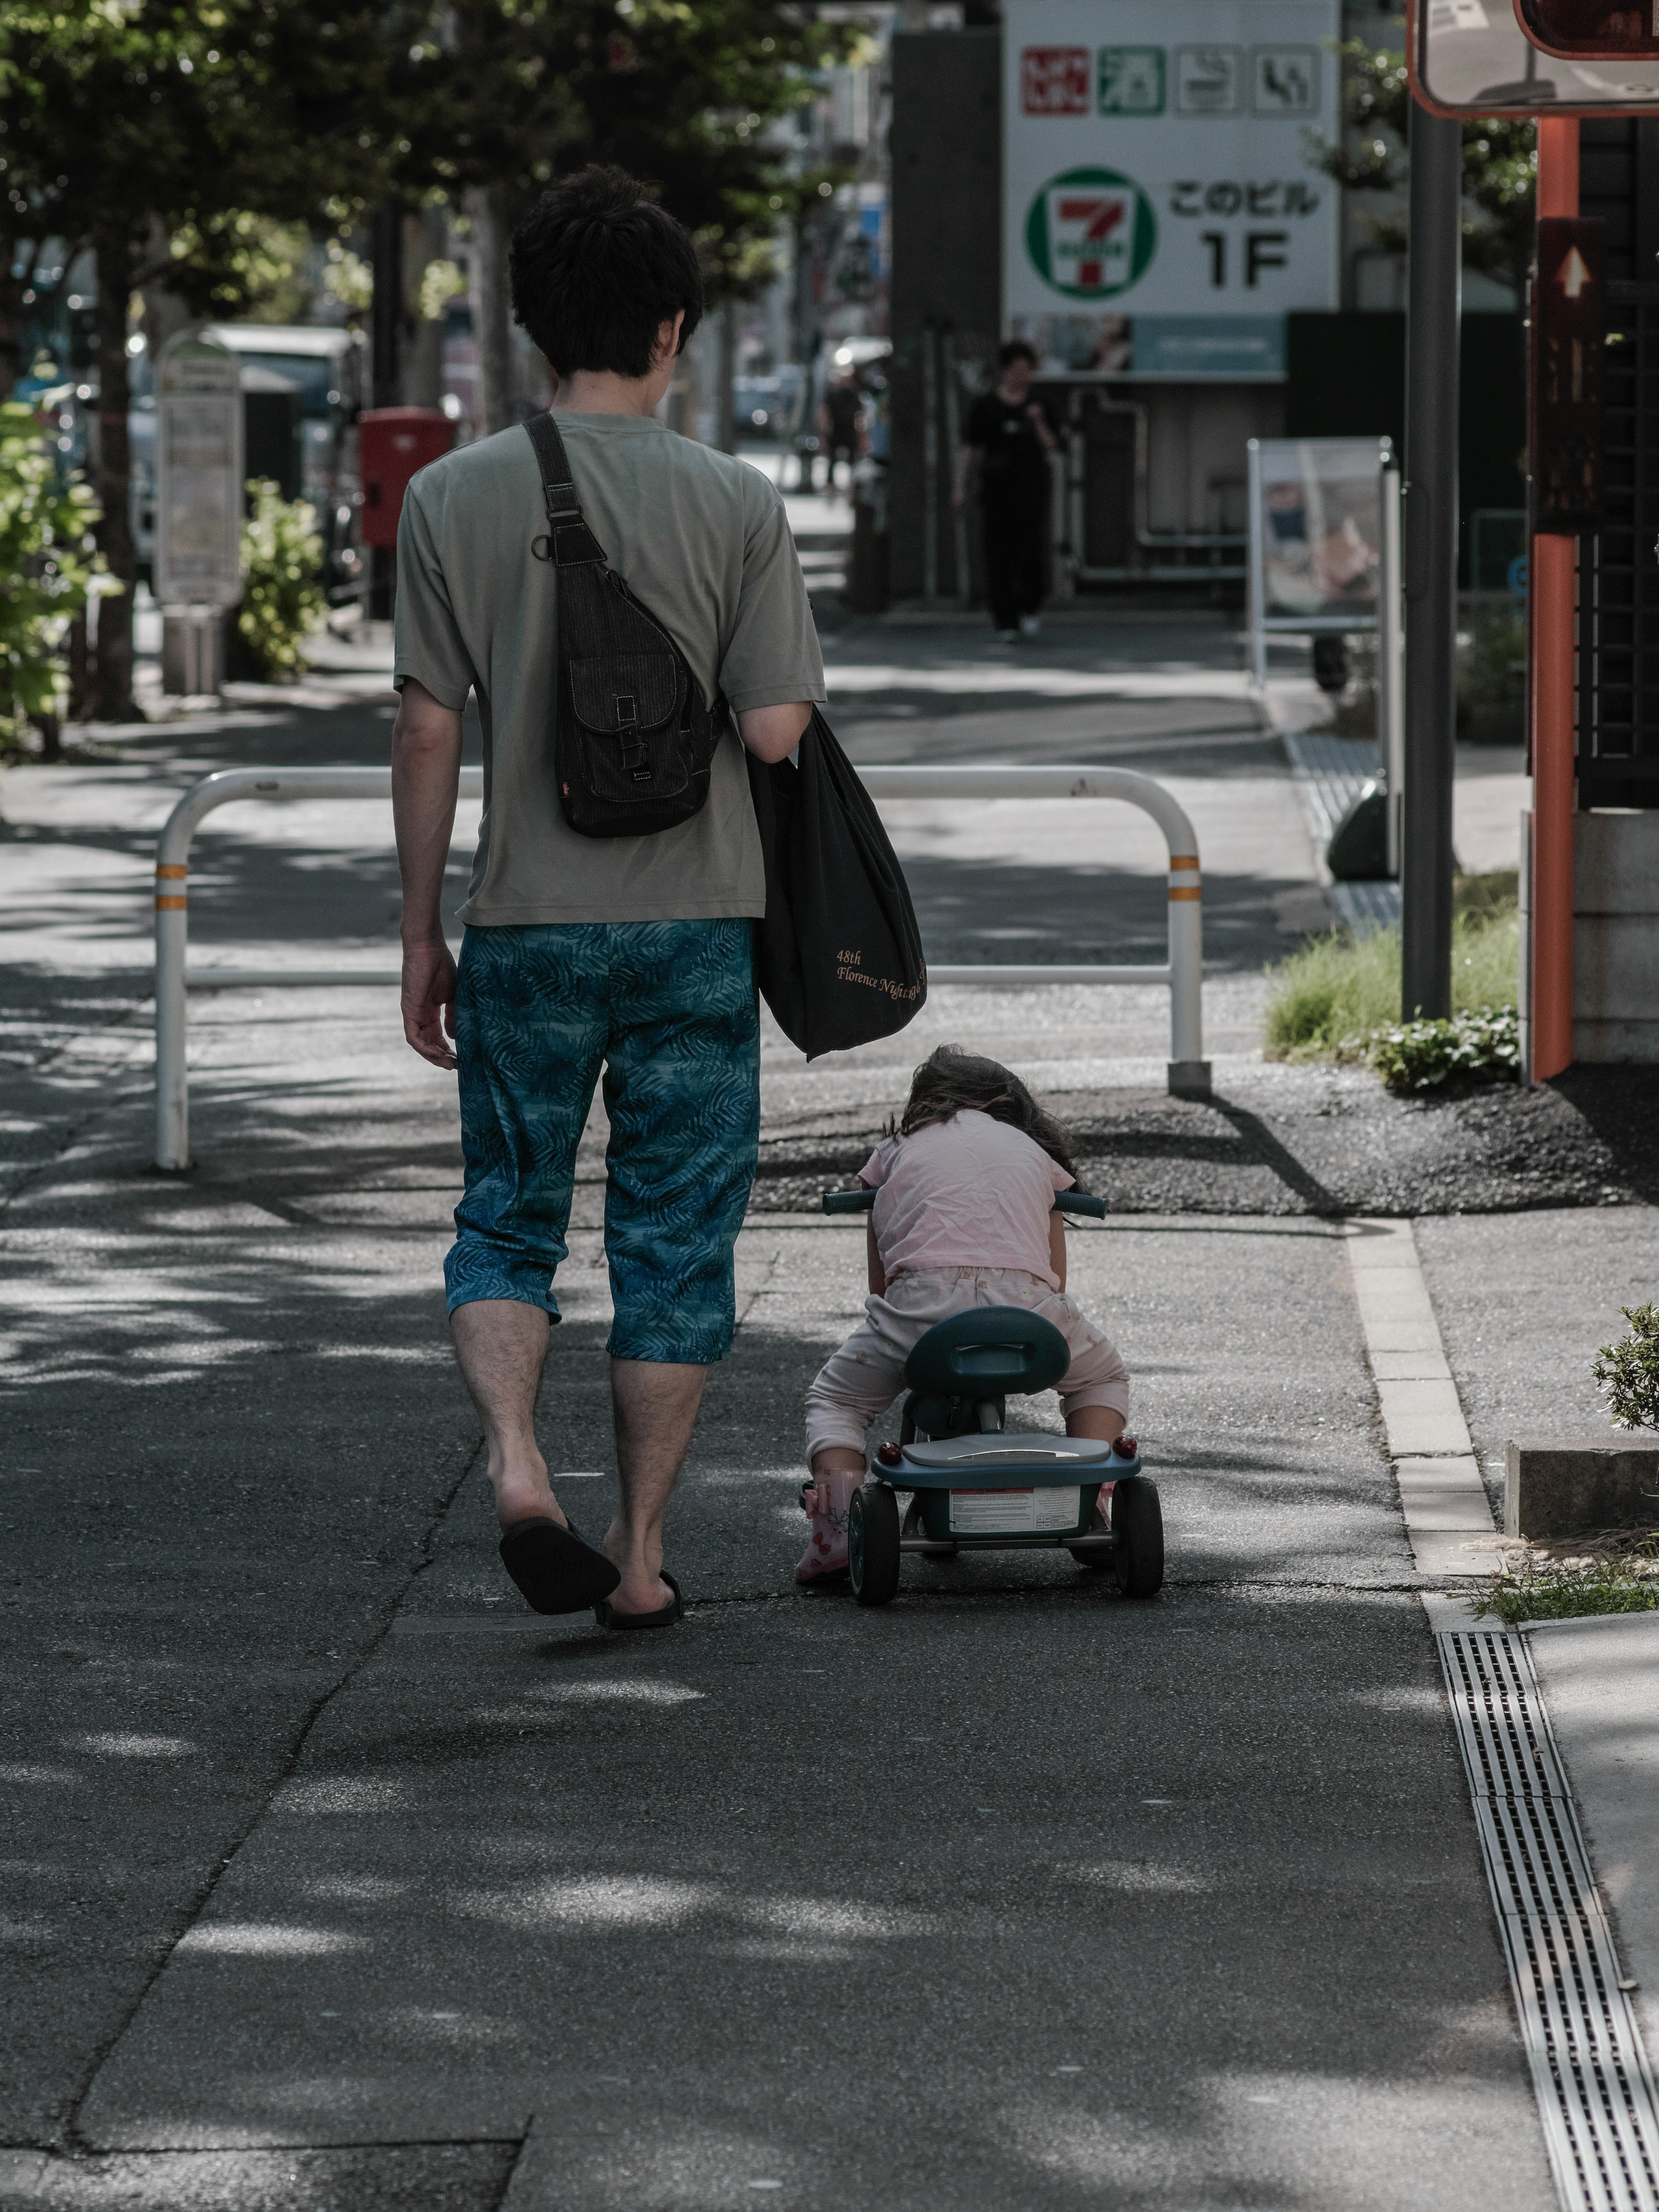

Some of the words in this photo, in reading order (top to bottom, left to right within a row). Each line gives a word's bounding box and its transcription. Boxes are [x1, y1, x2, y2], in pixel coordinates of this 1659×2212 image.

[1168, 180, 1321, 217] このビル
[1202, 231, 1290, 289] 1F
[836, 950, 861, 965] 48th
[837, 966, 877, 988] Florence
